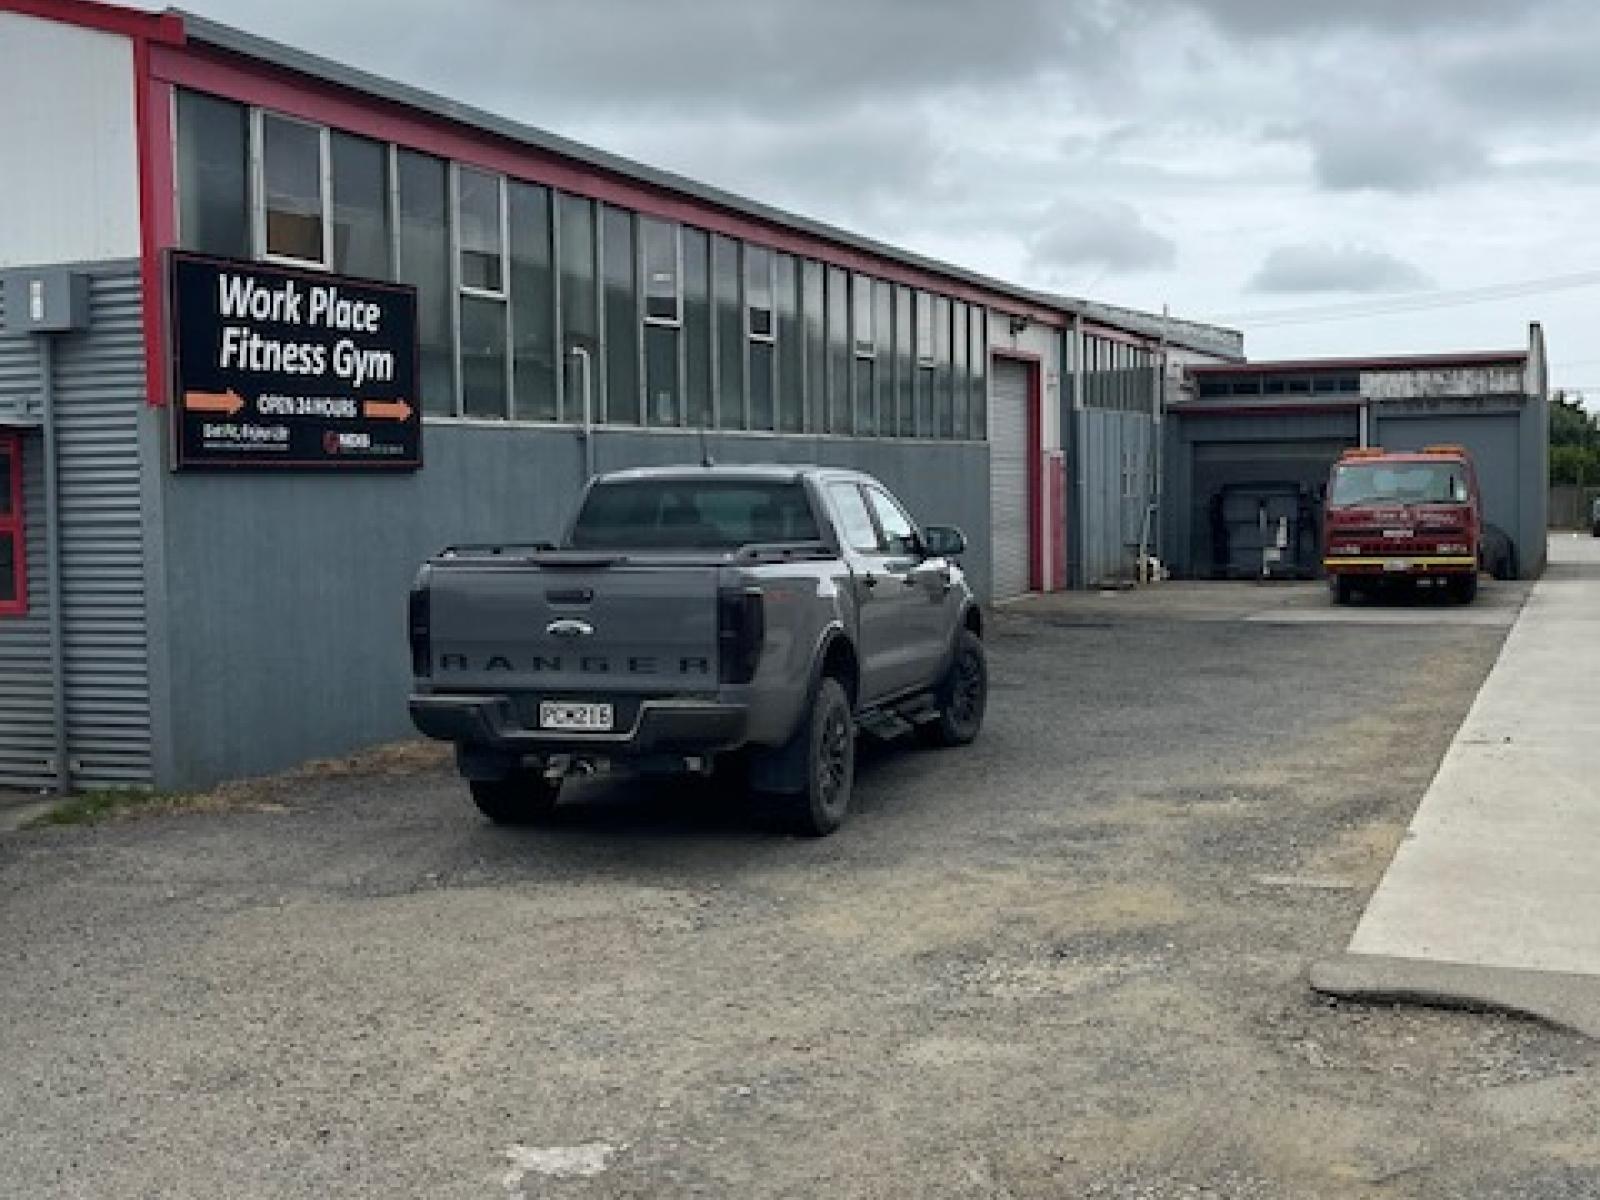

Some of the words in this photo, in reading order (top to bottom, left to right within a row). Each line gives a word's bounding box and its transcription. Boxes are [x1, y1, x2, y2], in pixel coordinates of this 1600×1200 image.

[219, 273, 301, 325] Work
[309, 286, 381, 333] Place
[219, 326, 326, 375] Fitness
[333, 338, 394, 388] Gym
[257, 393, 294, 415] OPEN
[441, 653, 710, 675] RANGER
